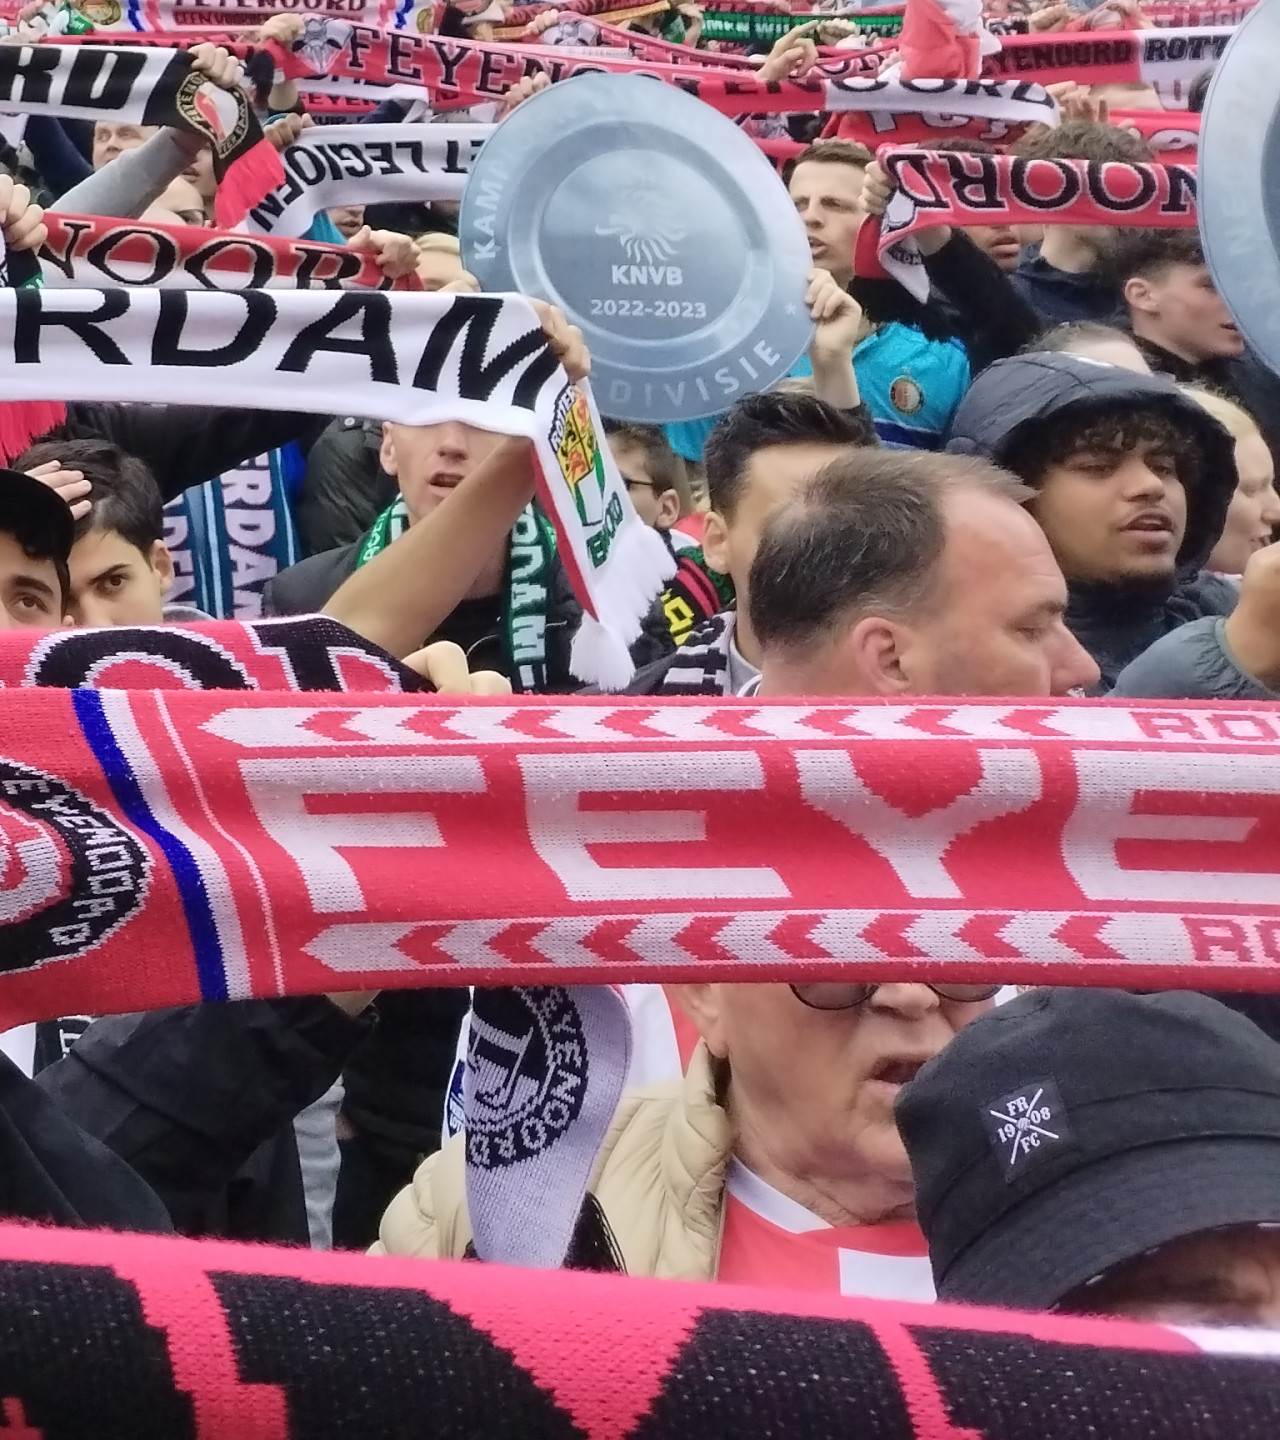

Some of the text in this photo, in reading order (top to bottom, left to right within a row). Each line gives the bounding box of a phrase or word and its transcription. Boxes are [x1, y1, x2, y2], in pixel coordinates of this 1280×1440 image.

[249, 140, 430, 234] LEGIOEN
[610, 263, 684, 287] KNVB
[590, 297, 707, 319] 2022-2023
[1005, 1096, 1029, 1117] FR
[996, 1106, 1052, 1144] 19 08
[1019, 1131, 1042, 1155] FC
